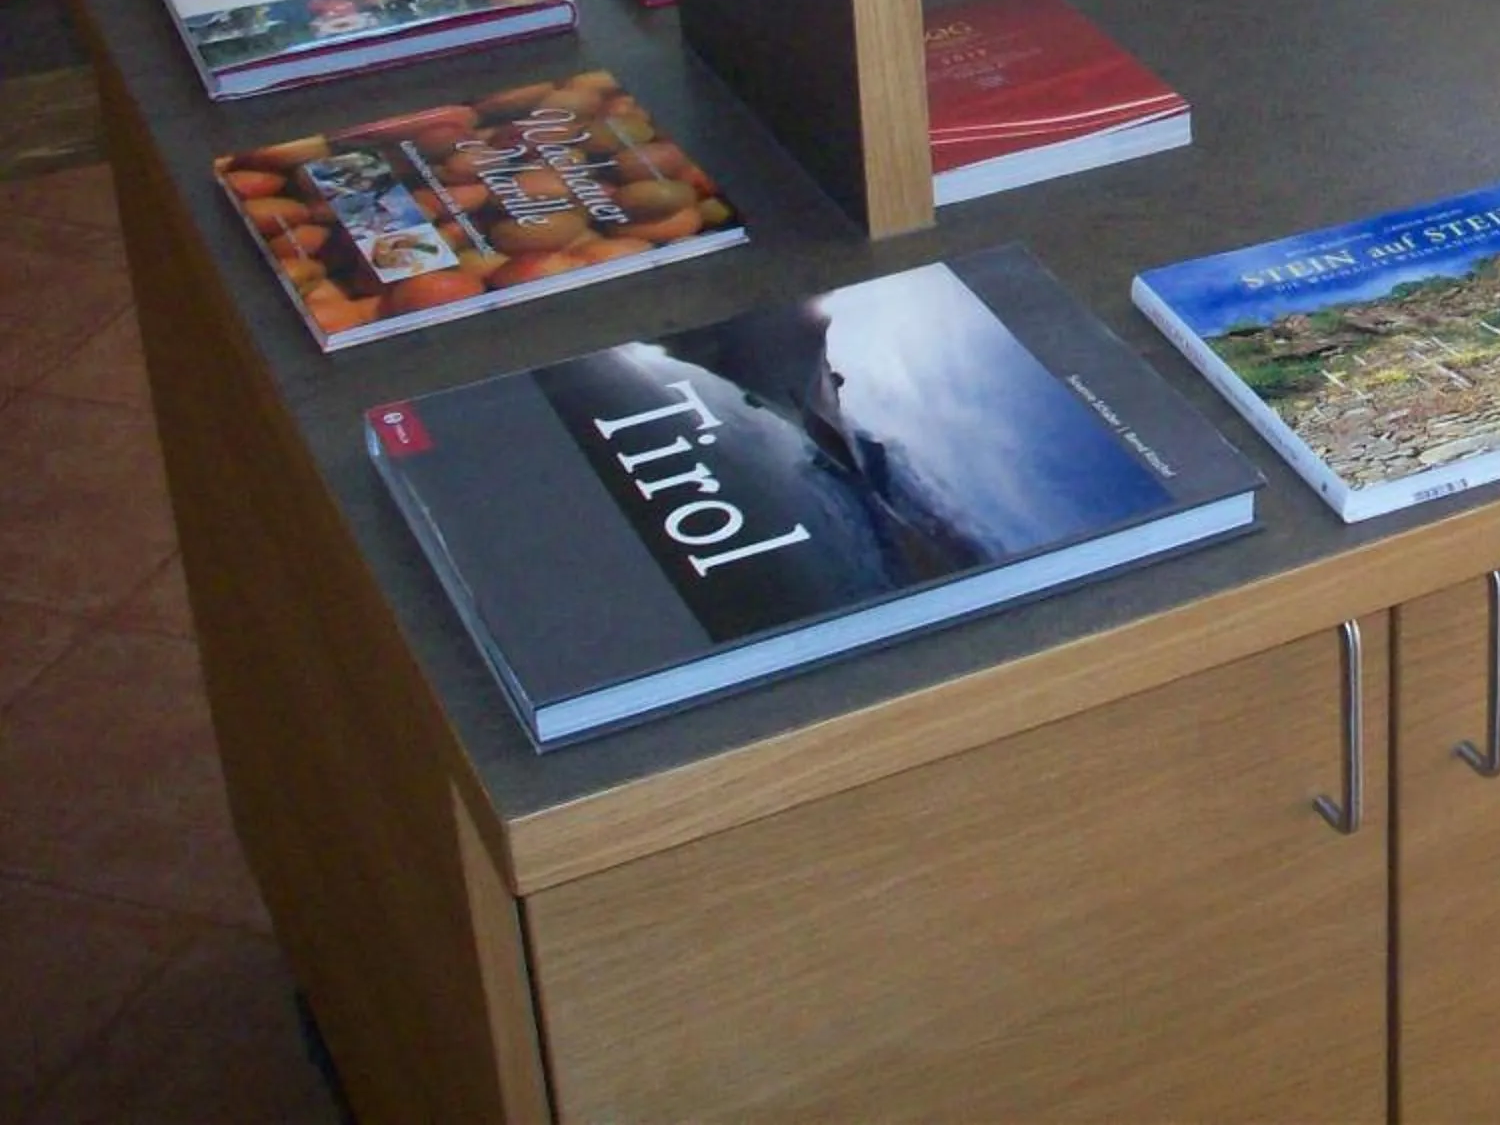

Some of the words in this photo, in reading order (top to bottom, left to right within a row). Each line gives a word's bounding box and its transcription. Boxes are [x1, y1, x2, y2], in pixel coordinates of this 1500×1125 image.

[455, 138, 577, 229] Marille
[511, 107, 632, 225] Wachauer
[1240, 249, 1357, 289] STEIN
[1366, 232, 1417, 259] auf
[593, 379, 812, 577] Tirol
